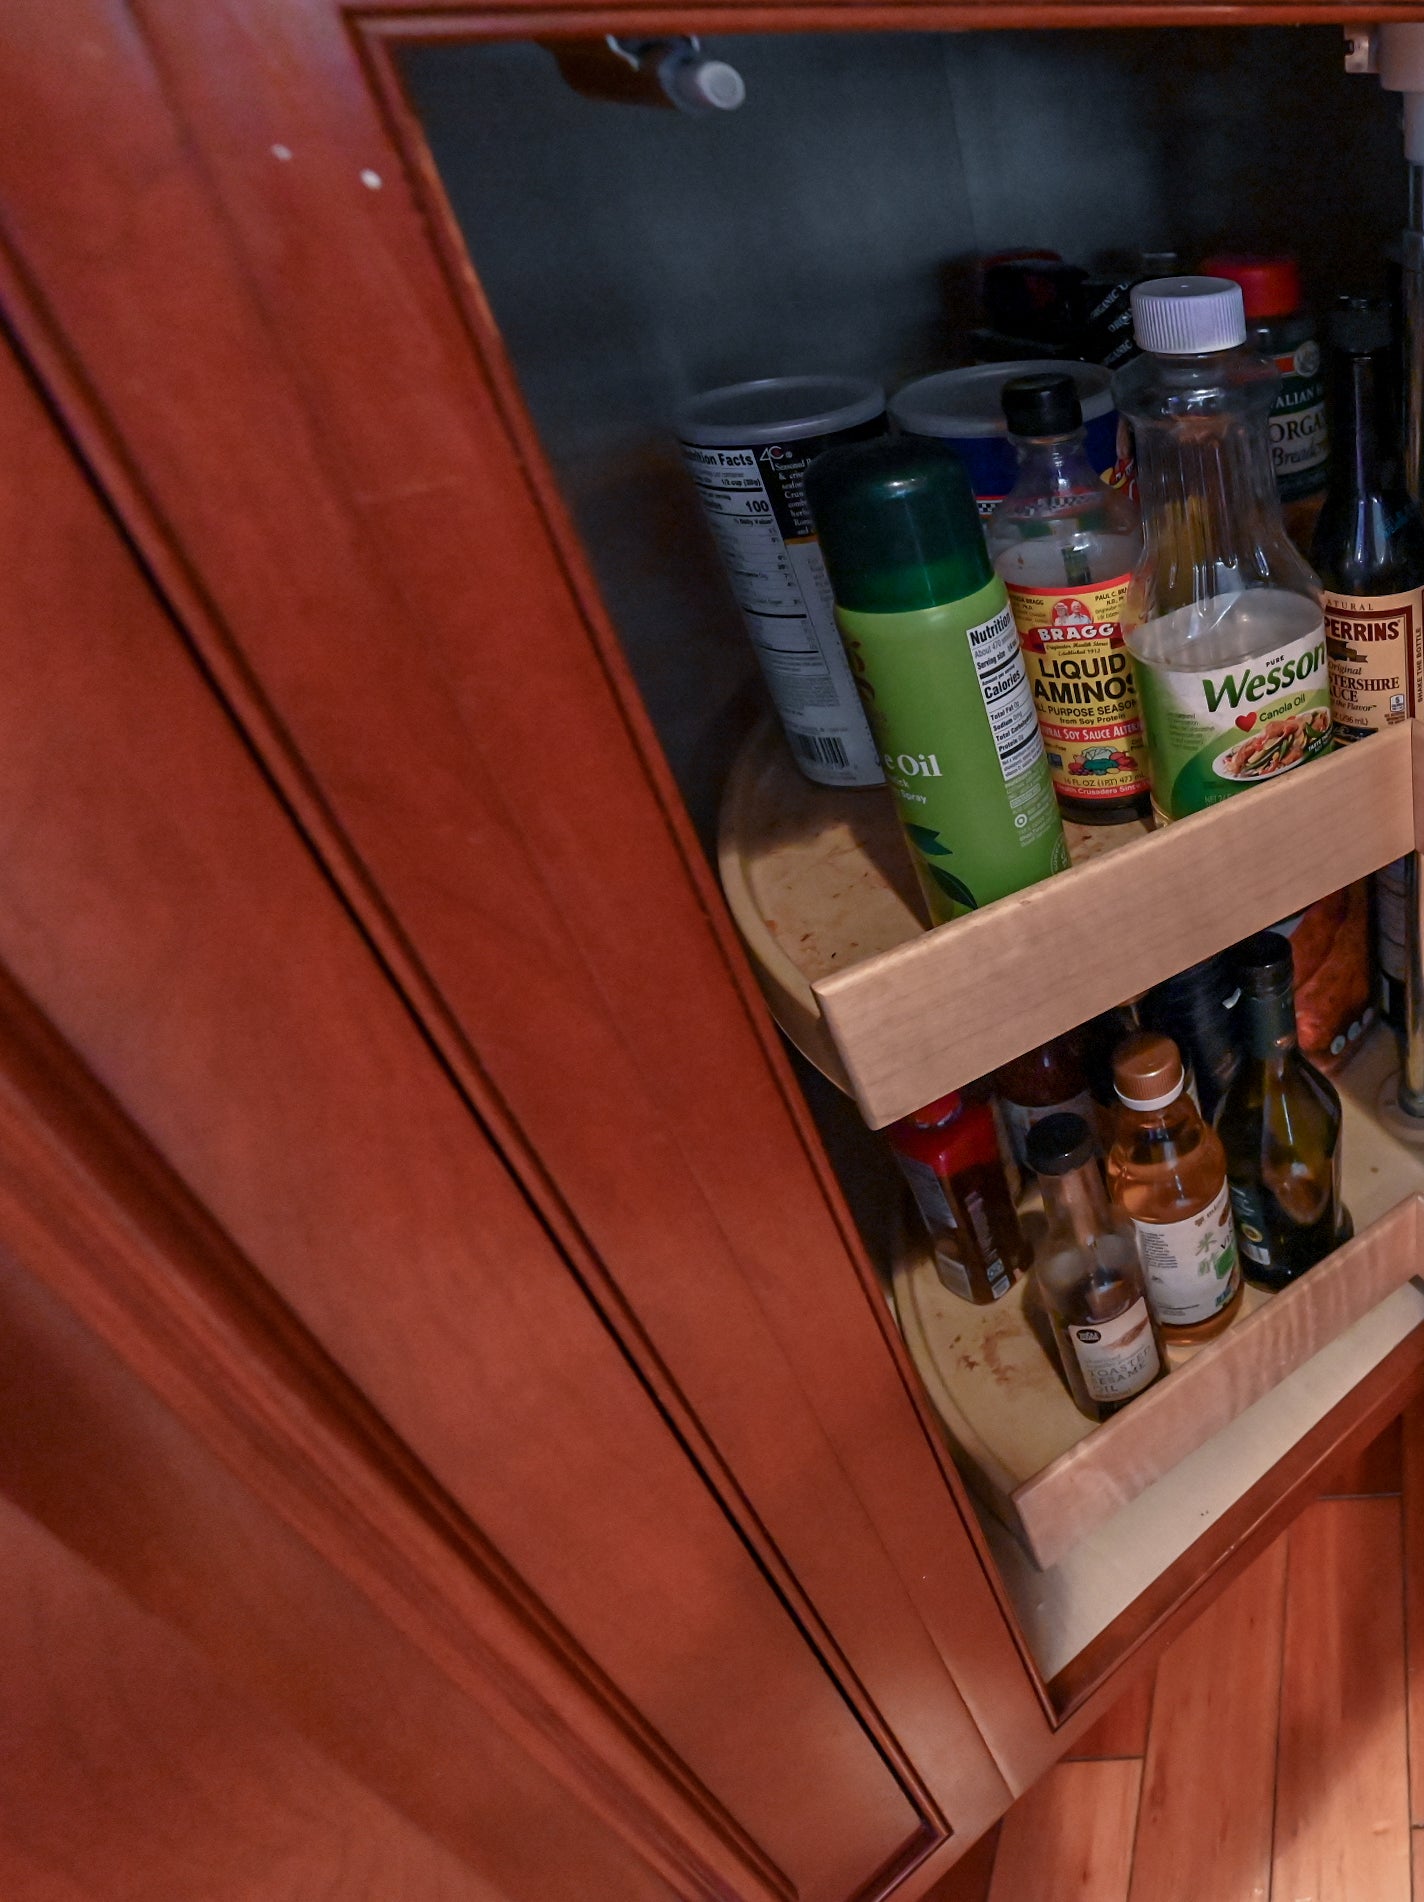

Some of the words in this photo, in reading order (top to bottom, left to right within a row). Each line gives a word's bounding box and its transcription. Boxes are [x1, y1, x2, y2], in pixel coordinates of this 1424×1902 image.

[1271, 386, 1315, 410] ALIAN
[717, 453, 753, 467] Facts
[745, 501, 769, 513] 100
[969, 612, 1011, 646] Nutrition
[1037, 623, 1115, 641] BRAGG
[1038, 653, 1126, 680] LIQUID
[1265, 654, 1285, 667] PURE
[1328, 661, 1362, 675] Original
[984, 670, 1020, 699] Calories
[1202, 640, 1326, 713] Wesson
[1047, 705, 1095, 717] PURPOSE
[1259, 703, 1292, 722] Canola
[1294, 693, 1306, 707] Oil
[1079, 718, 1094, 726] Soy
[1097, 713, 1126, 723] Protein
[1064, 728, 1080, 740] SOY
[1083, 728, 1111, 740] SAUCE
[896, 753, 943, 777] Oil
[1078, 787, 1118, 796] Crusaders
